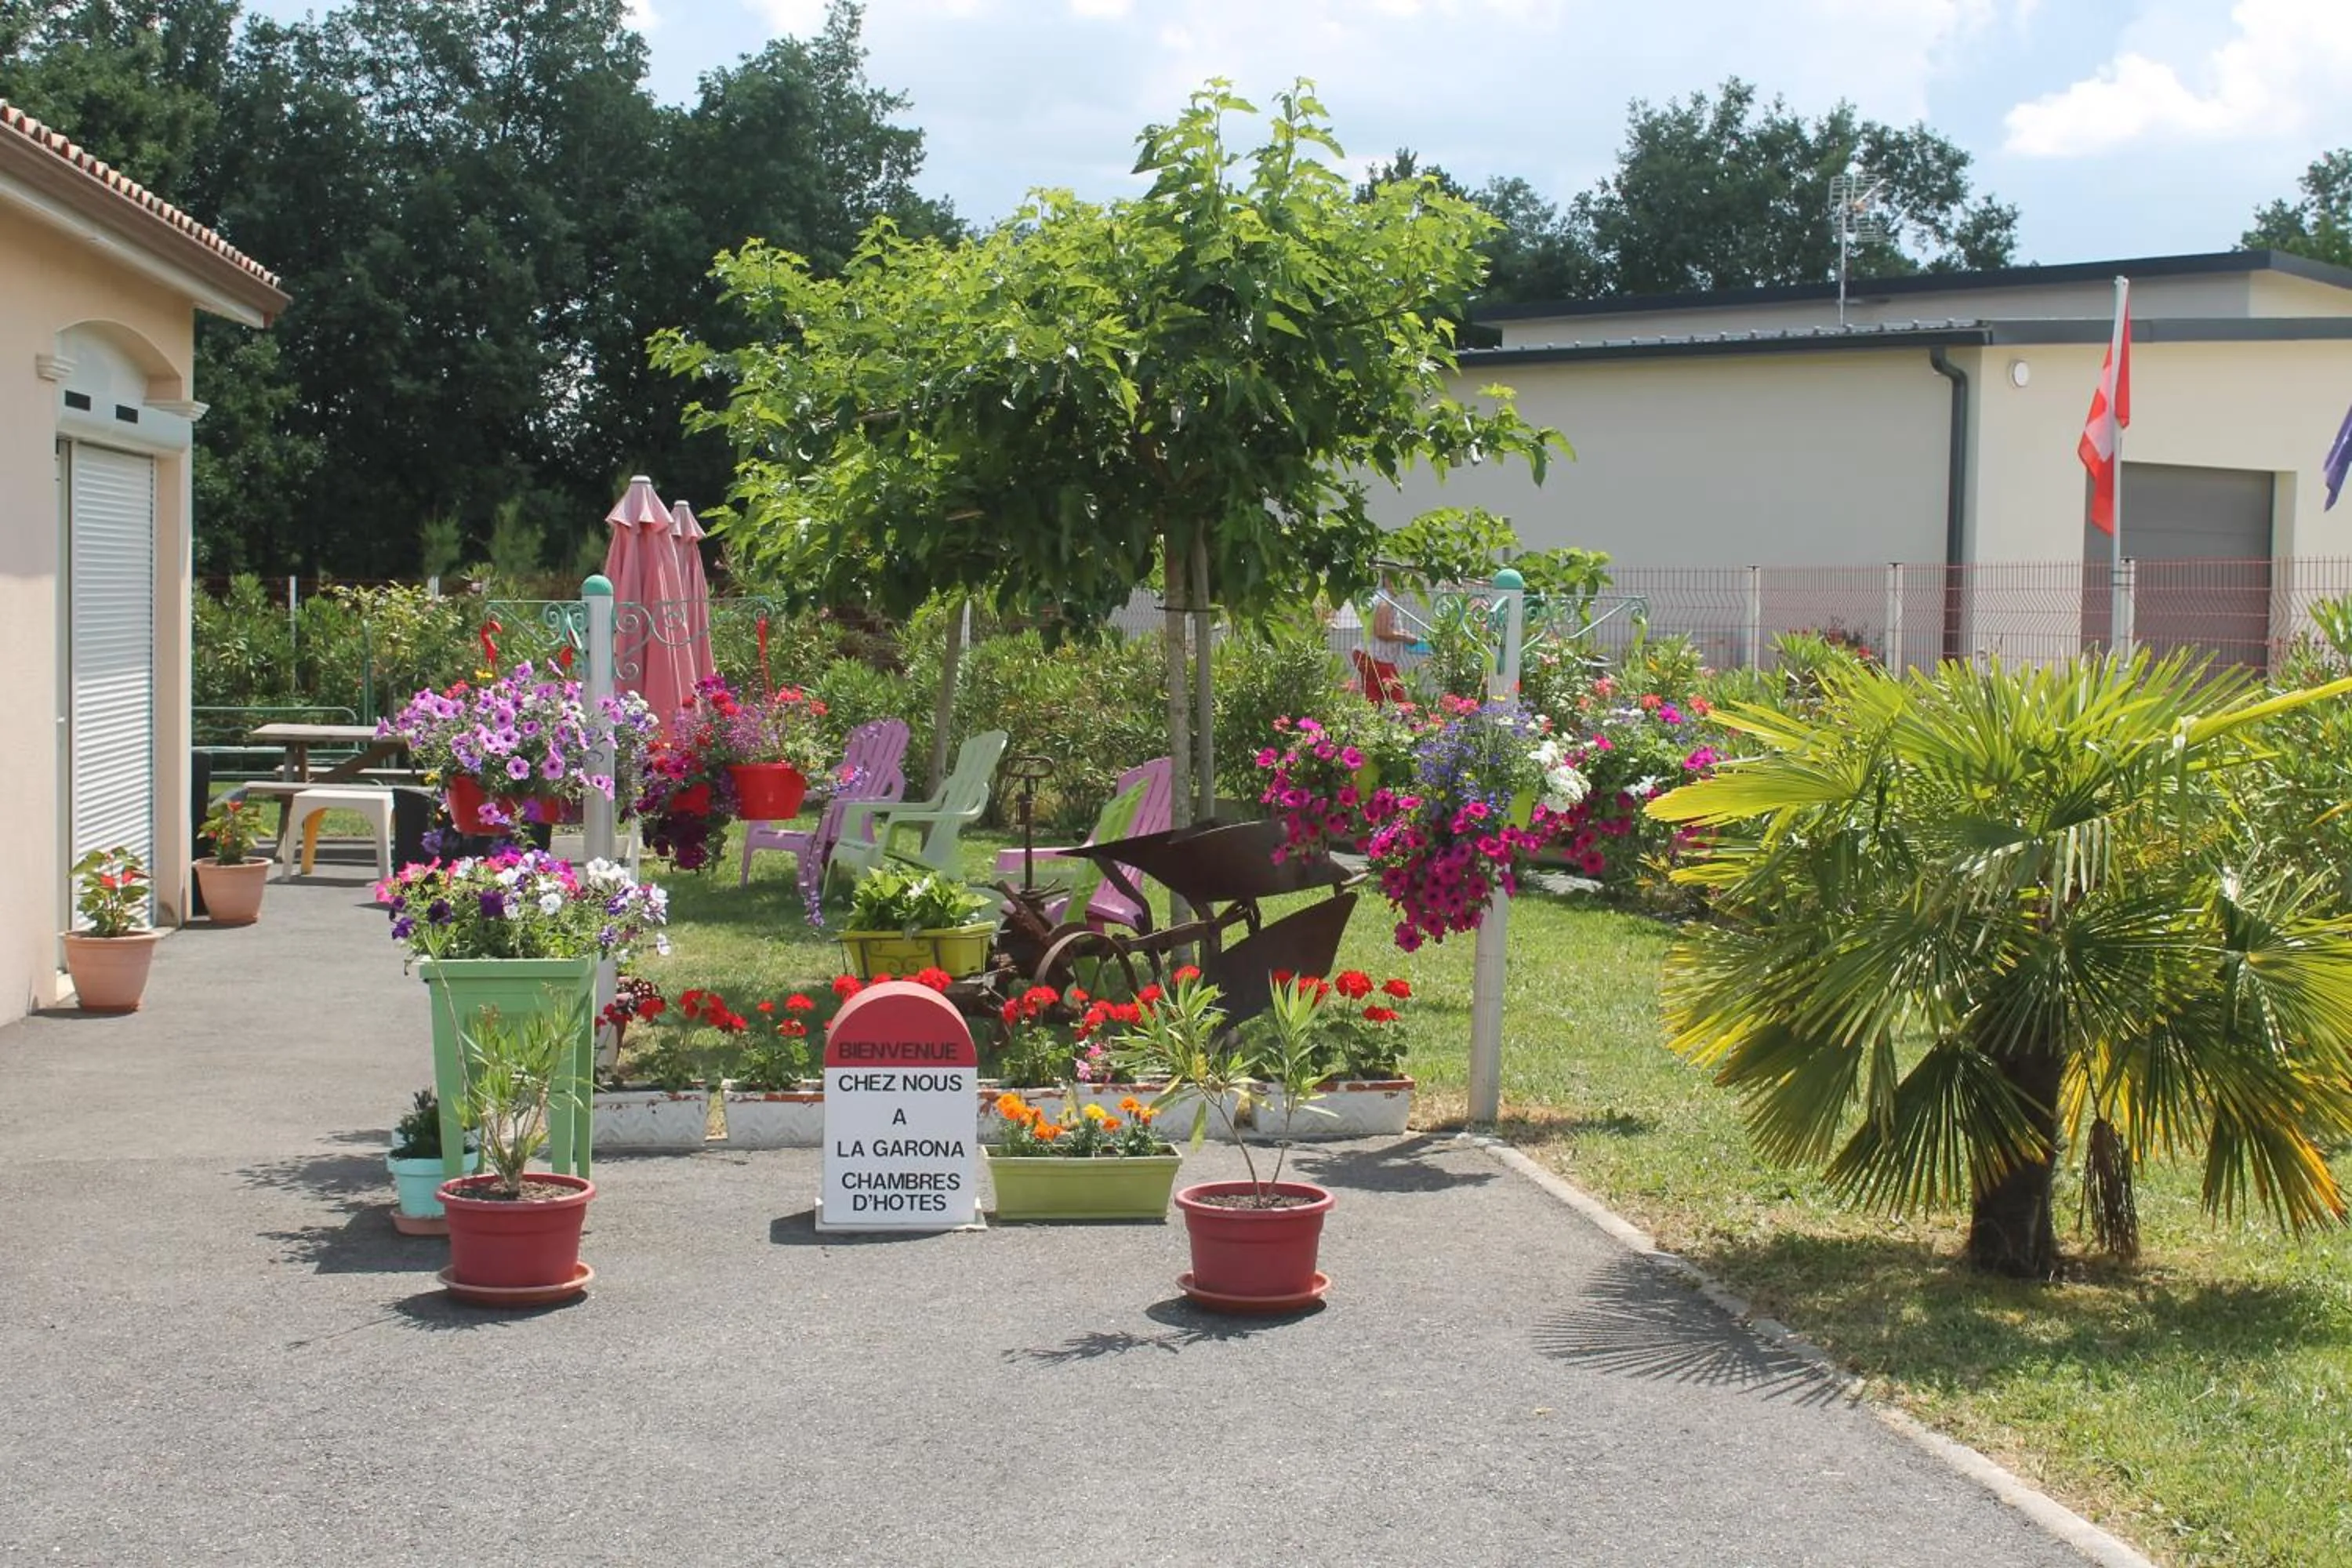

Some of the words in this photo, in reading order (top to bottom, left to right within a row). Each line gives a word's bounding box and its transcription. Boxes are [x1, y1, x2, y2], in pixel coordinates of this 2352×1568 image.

[838, 1042, 959, 1059] BIENVENUE
[838, 1074, 895, 1091] CHEZ
[902, 1075, 962, 1091] NOUS
[892, 1108, 906, 1125] A
[837, 1141, 864, 1157] LA
[873, 1140, 964, 1157] GARONA
[841, 1172, 960, 1190] CHAMBRES
[853, 1194, 946, 1211] D'HOTES
